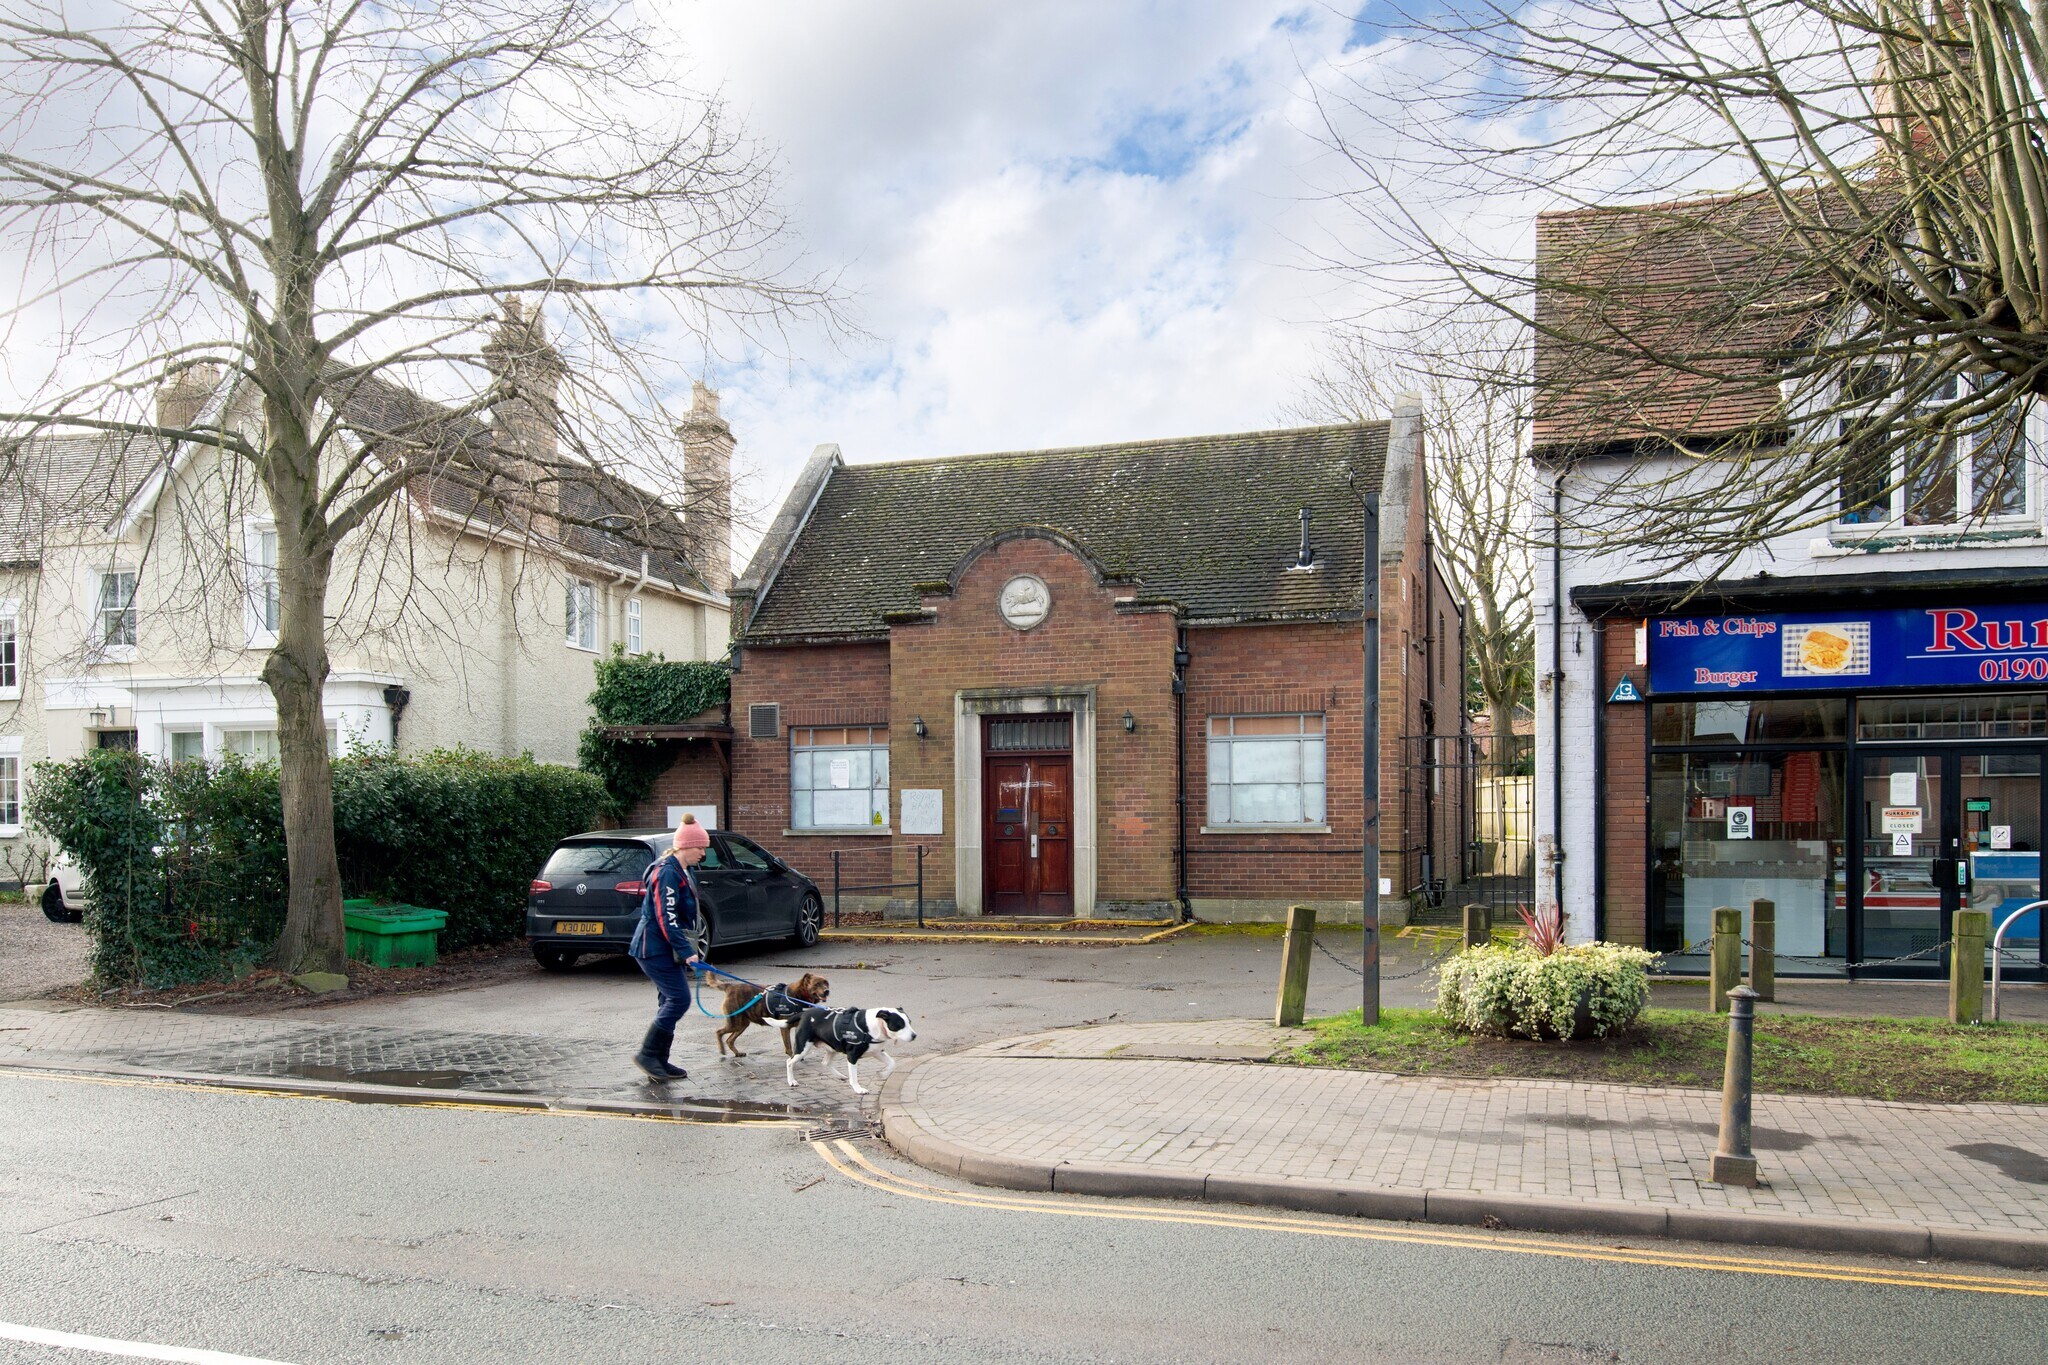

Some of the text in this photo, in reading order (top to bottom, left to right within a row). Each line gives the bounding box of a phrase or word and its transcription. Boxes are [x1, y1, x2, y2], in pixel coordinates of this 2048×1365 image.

[1659, 618, 1777, 638] Fish & Chips
[1694, 667, 1758, 687] Burger
[1979, 657, 2048, 682] 0190
[666, 886, 679, 928] ARIAT
[562, 923, 597, 933] X30 DUG
